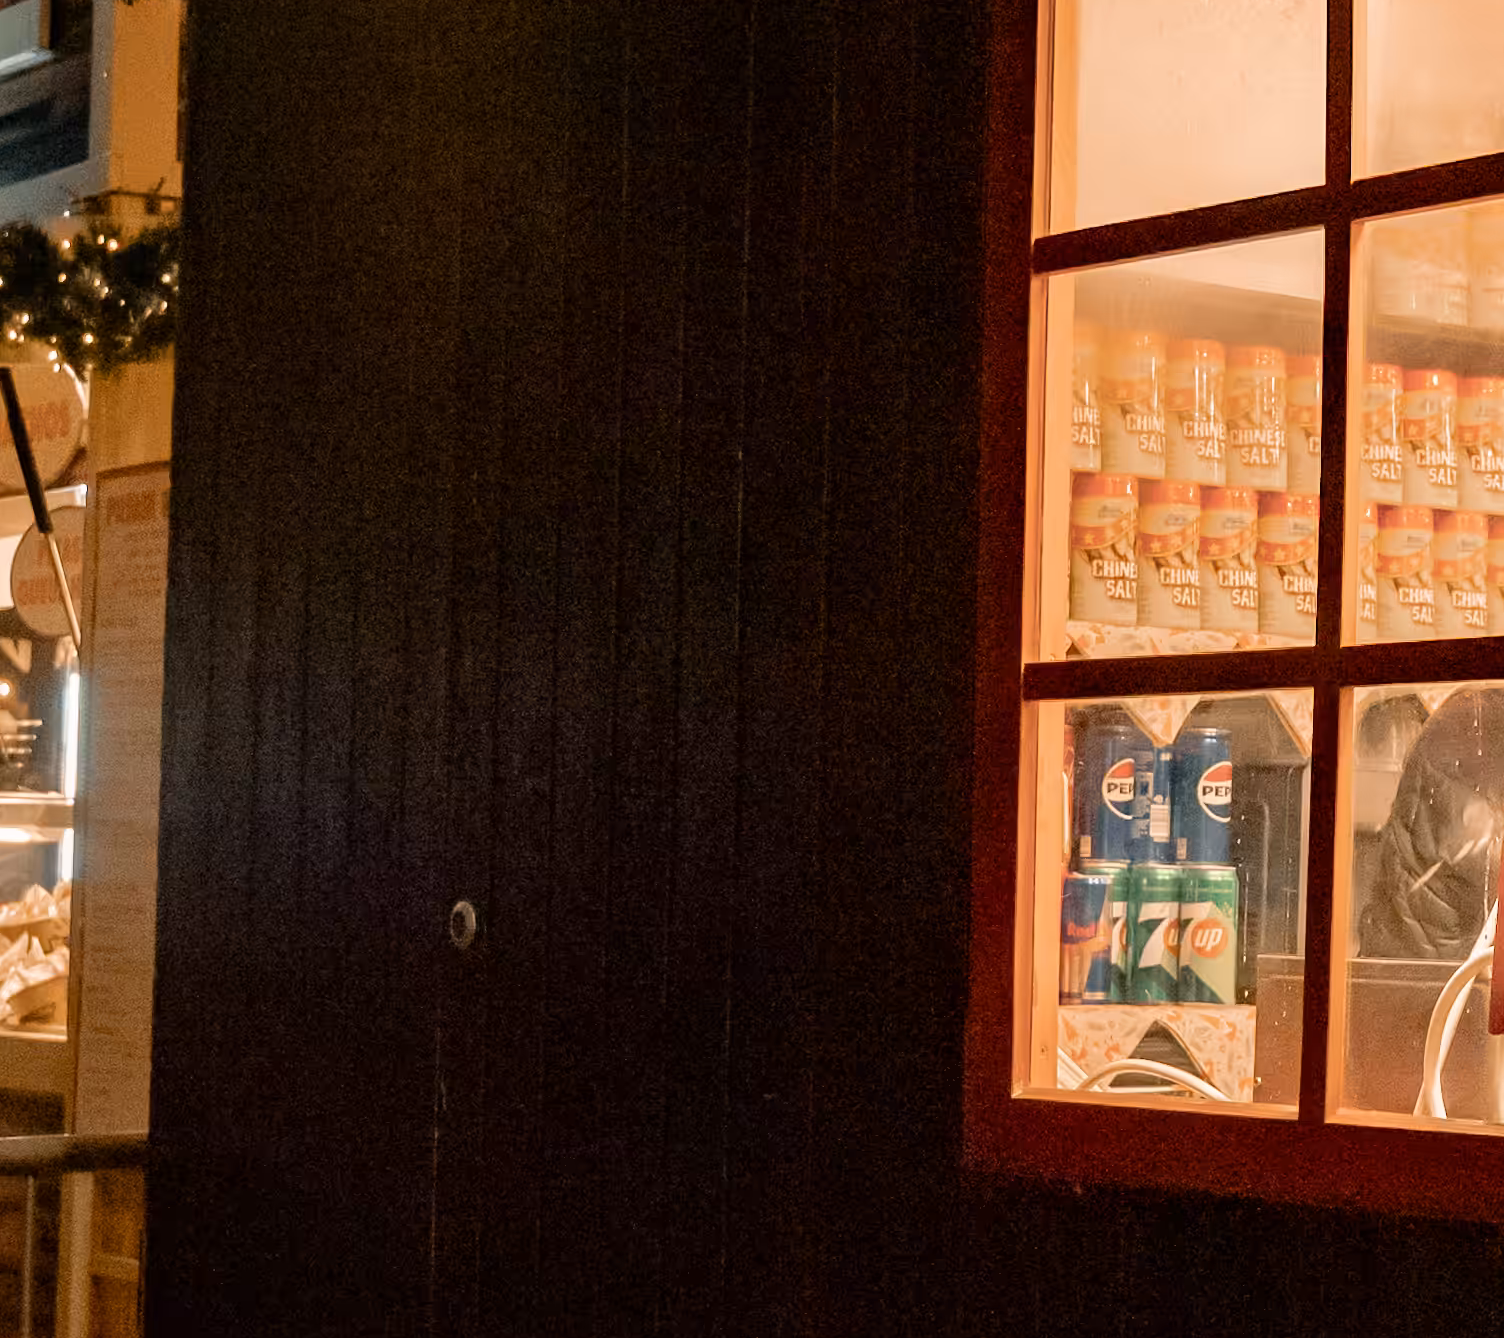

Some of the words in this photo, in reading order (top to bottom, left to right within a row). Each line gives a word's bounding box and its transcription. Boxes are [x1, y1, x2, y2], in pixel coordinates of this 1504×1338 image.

[1184, 420, 1226, 440] CHINE
[1241, 448, 1280, 465] SALT
[1361, 443, 1402, 462] CHINE
[1416, 447, 1457, 469] CHINE
[1092, 558, 1137, 579] CHINE
[1202, 785, 1232, 797] PEP
